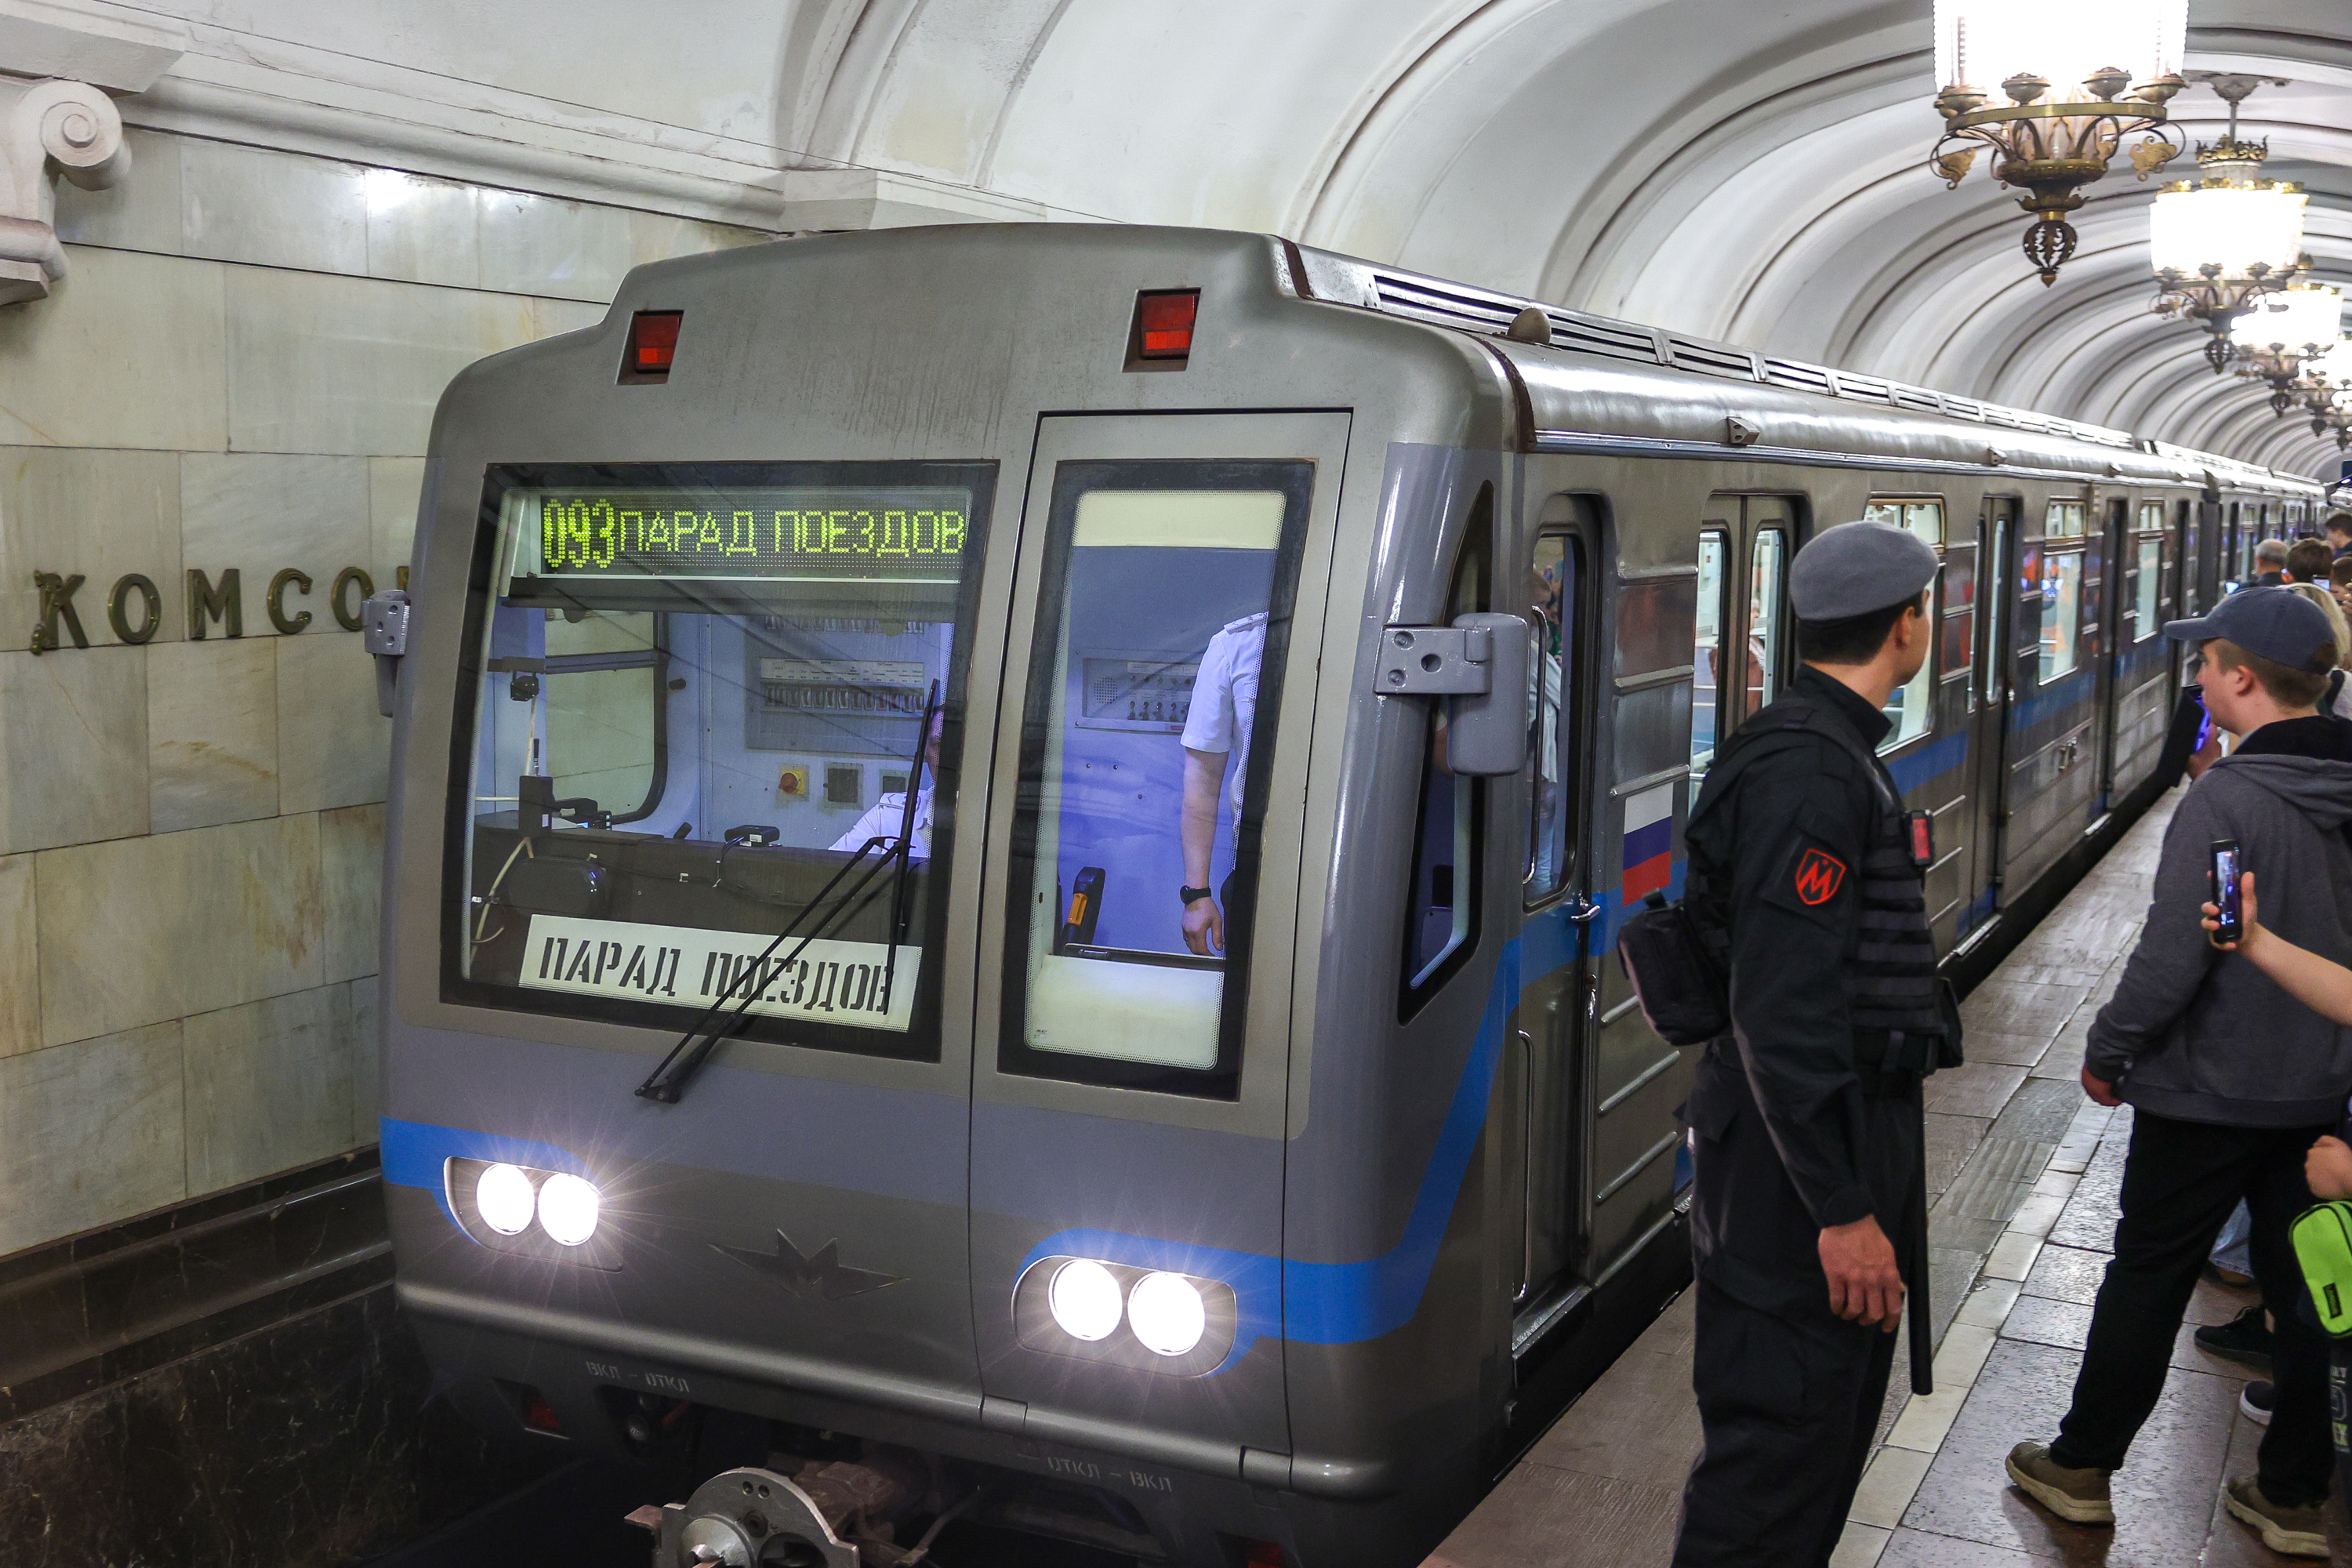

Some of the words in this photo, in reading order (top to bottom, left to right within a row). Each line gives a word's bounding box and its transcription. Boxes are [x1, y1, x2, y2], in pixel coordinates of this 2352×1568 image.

[543, 499, 615, 568] 093
[619, 511, 757, 556] ПАРАД
[774, 510, 964, 557] ПОЕЗДОВ
[31, 565, 410, 655] КОМСО
[539, 937, 681, 996] ПАРАД
[586, 1361, 620, 1379] ВКЛ
[644, 1372, 690, 1393] ОТКЛ
[1047, 1457, 1101, 1479] ОТКЛ
[1130, 1471, 1172, 1493] ВКЛ
